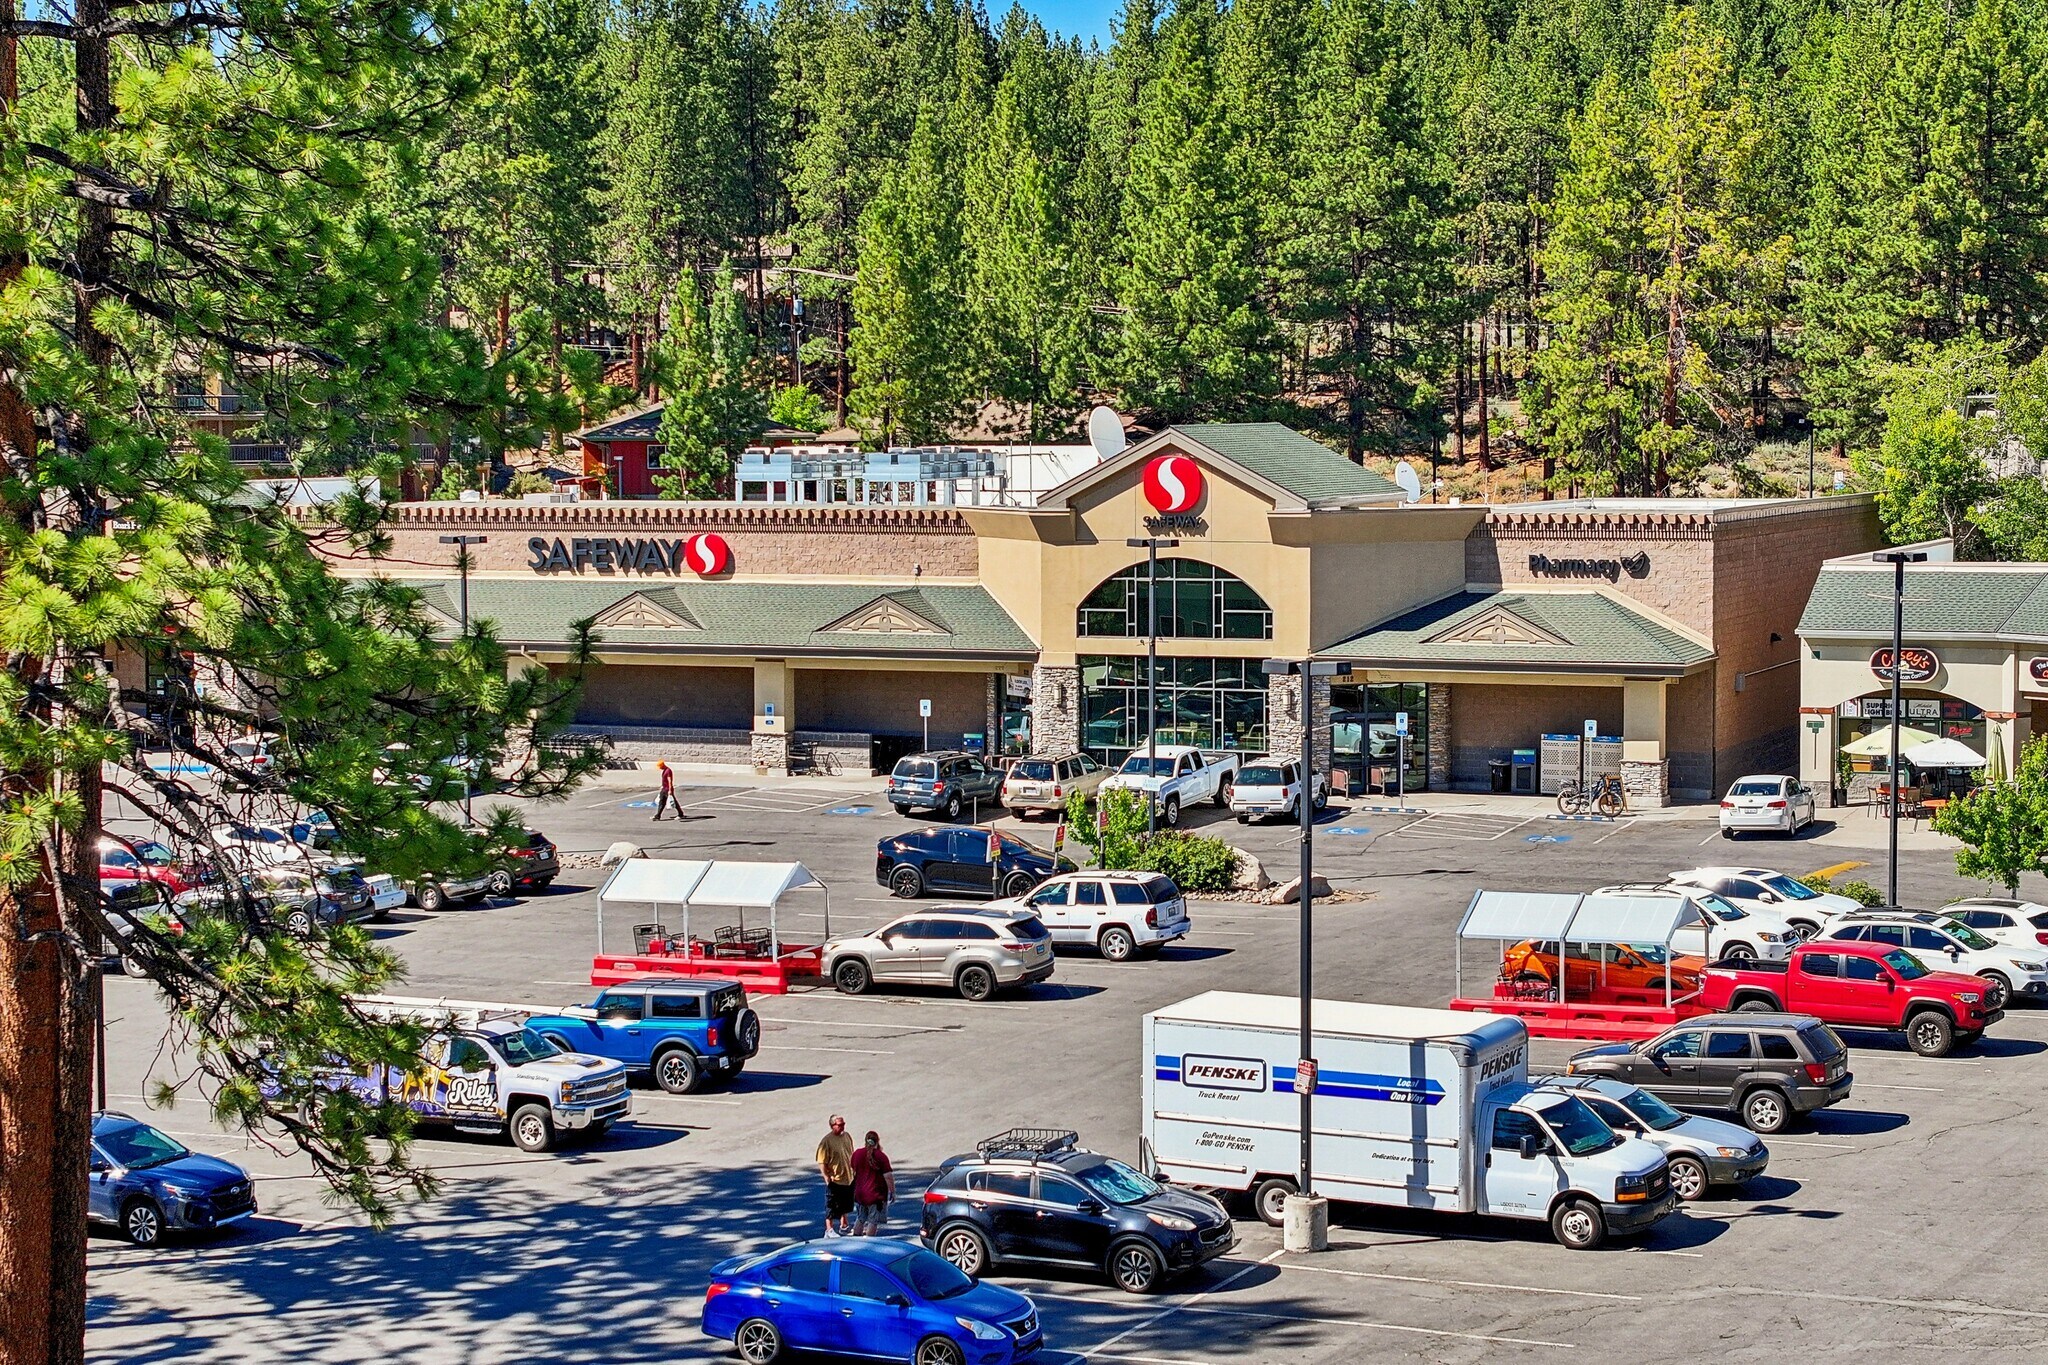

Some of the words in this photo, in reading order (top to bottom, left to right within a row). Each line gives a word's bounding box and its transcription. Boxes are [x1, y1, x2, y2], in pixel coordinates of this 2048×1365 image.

[1143, 515, 1202, 528] SAFEWAY
[528, 537, 684, 569] SAFEWAY
[1528, 553, 1617, 575] Pharmacy
[1909, 708, 1938, 716] ULTRA
[1947, 726, 1973, 736] Pizza
[1480, 1046, 1523, 1082] PENSKE
[1189, 1065, 1259, 1081] PENSKE
[1396, 1078, 1419, 1088] Local
[448, 1078, 497, 1107] Riley
[1198, 1090, 1216, 1099] Truck
[1217, 1093, 1240, 1101] Rental
[1390, 1091, 1406, 1102] One
[1407, 1093, 1425, 1104] Way
[1202, 1131, 1251, 1143] GoPenske.com
[1226, 1142, 1255, 1152] PENSKE
[1371, 1152, 1399, 1160] Dedication
